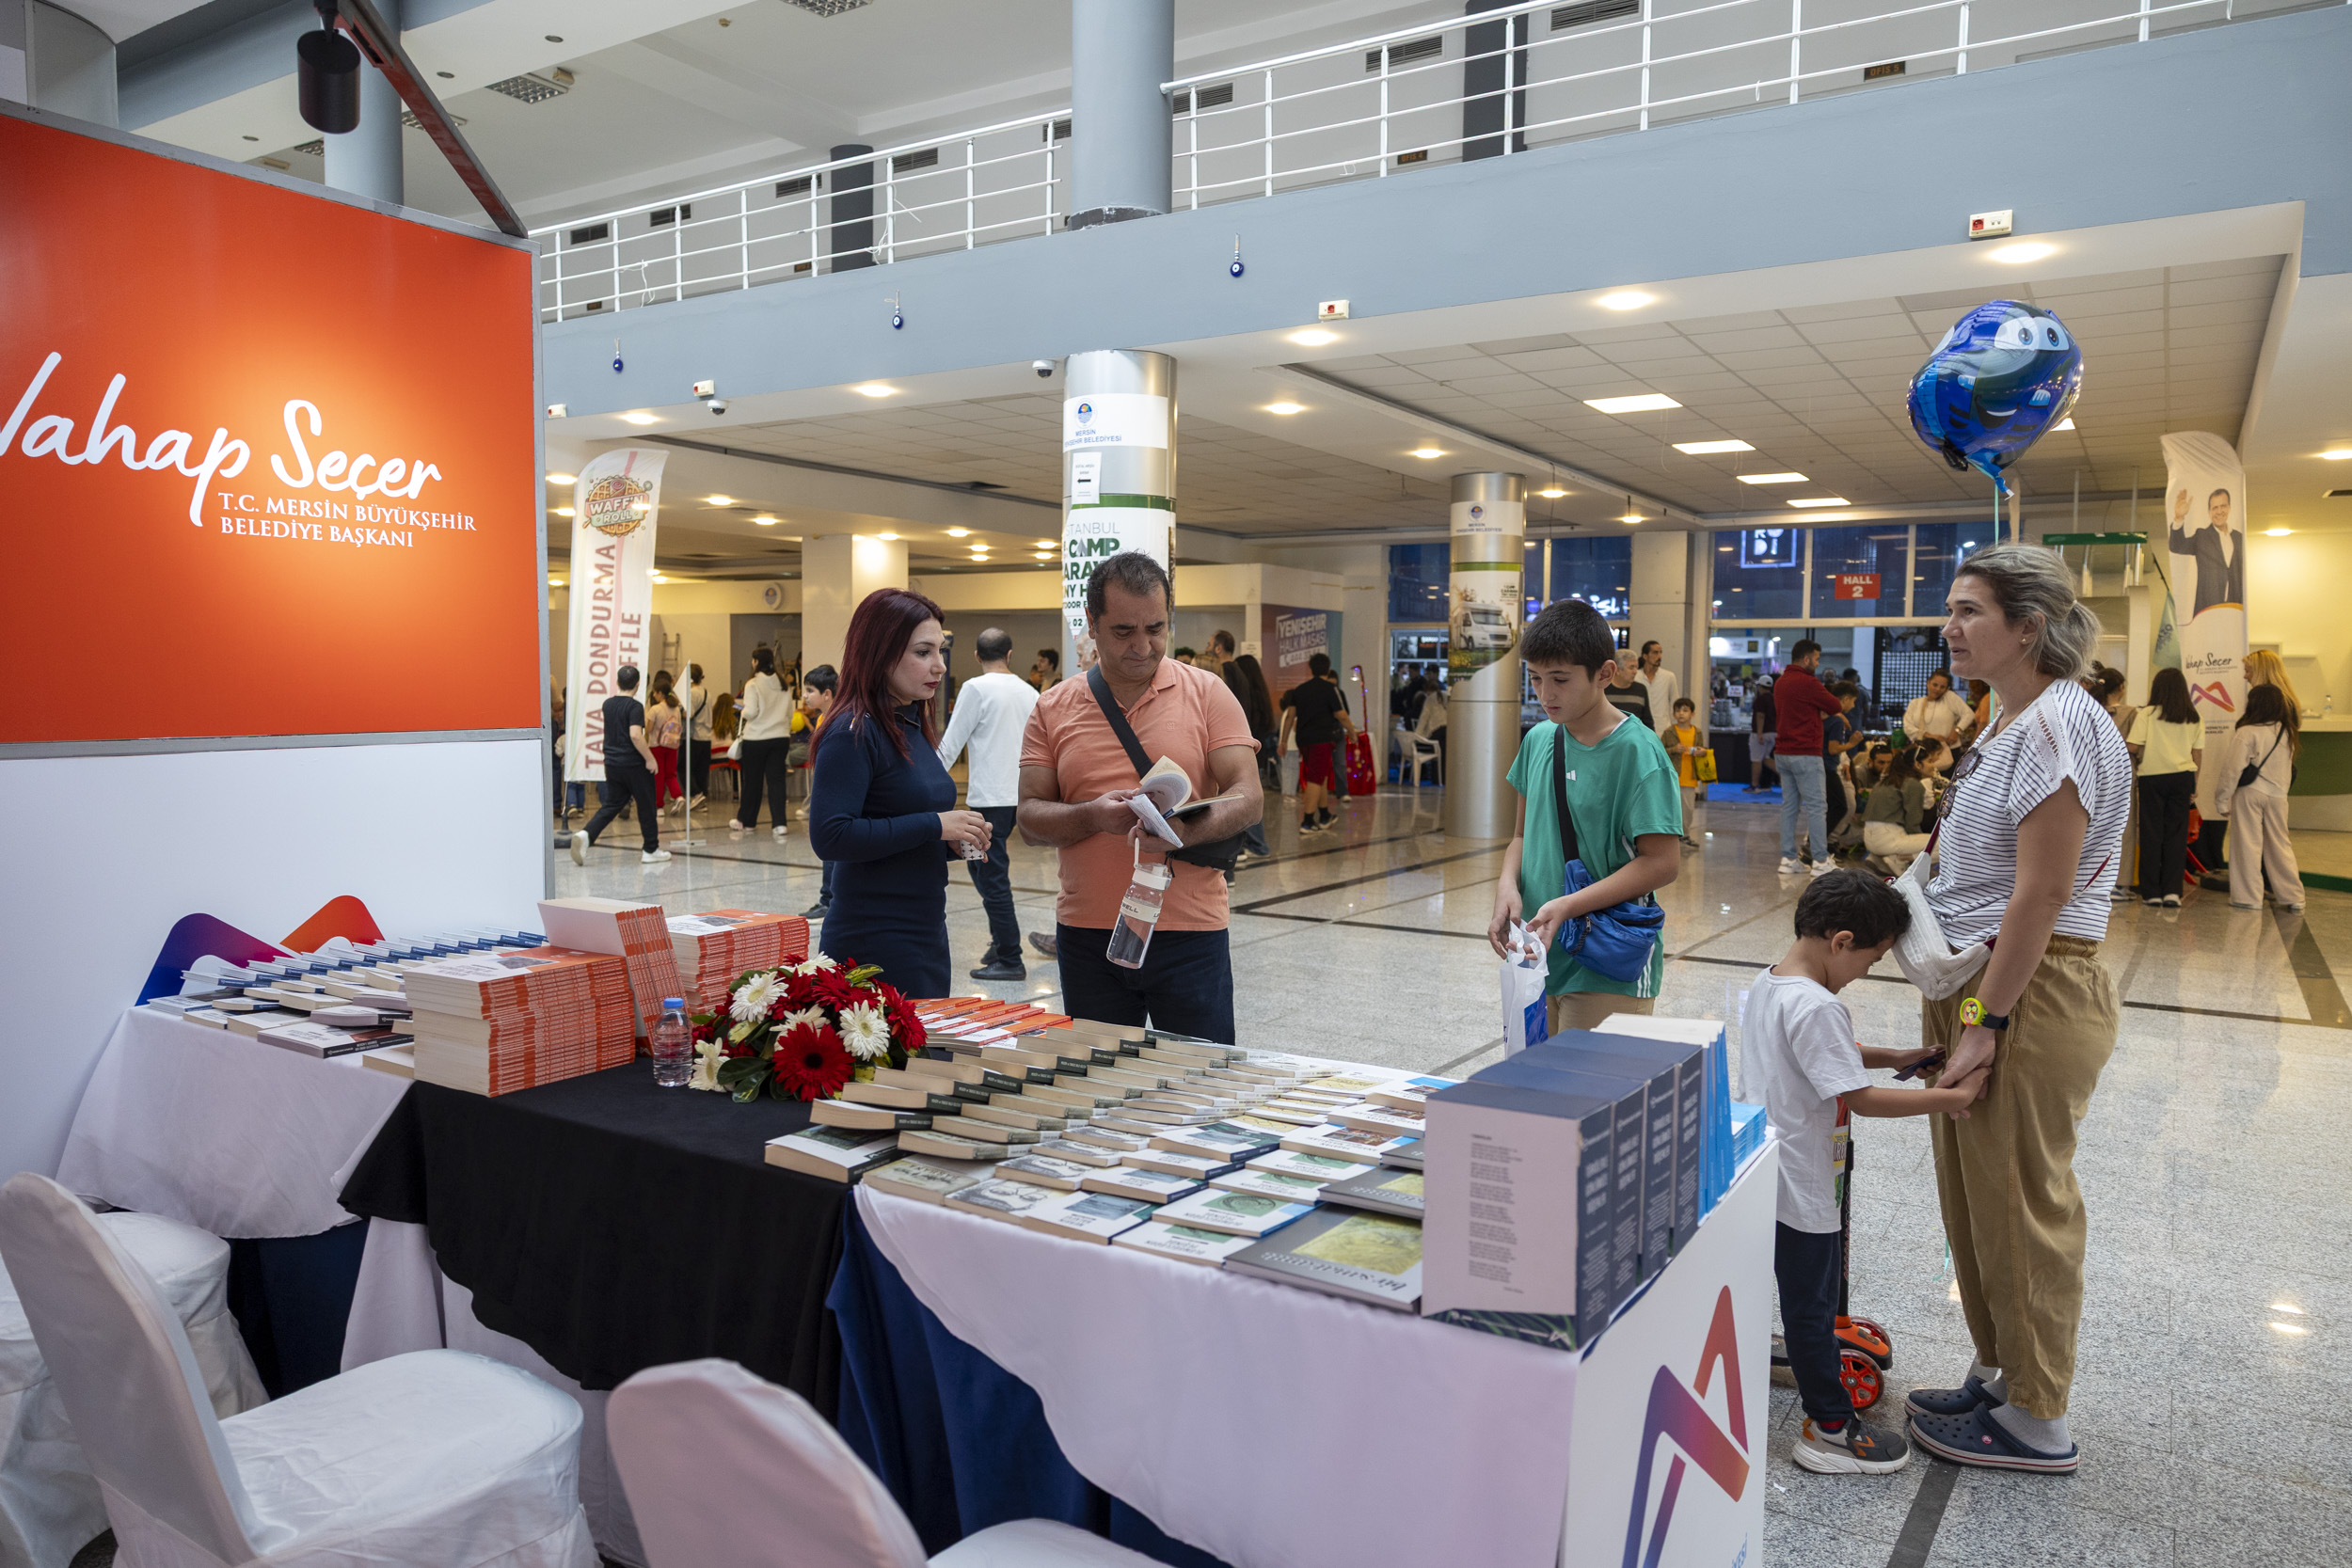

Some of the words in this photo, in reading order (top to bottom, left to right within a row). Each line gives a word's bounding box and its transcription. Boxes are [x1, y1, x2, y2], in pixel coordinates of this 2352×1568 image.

[271, 399, 442, 500] Seçer
[218, 492, 259, 514] T.C.
[266, 496, 349, 521] MERSİN
[356, 502, 477, 531] BÜYÜKŞEHİR
[603, 511, 632, 524] ROLL
[220, 516, 323, 542] BELEDİYE
[329, 526, 414, 548] BAŞKANI
[1065, 522, 1120, 536] STANBUL
[1843, 576, 1873, 584] HALL
[1851, 586, 1864, 597] 2
[587, 544, 616, 694] DONDURMA
[619, 612, 642, 667] FFLE
[1279, 637, 1299, 654] HALK
